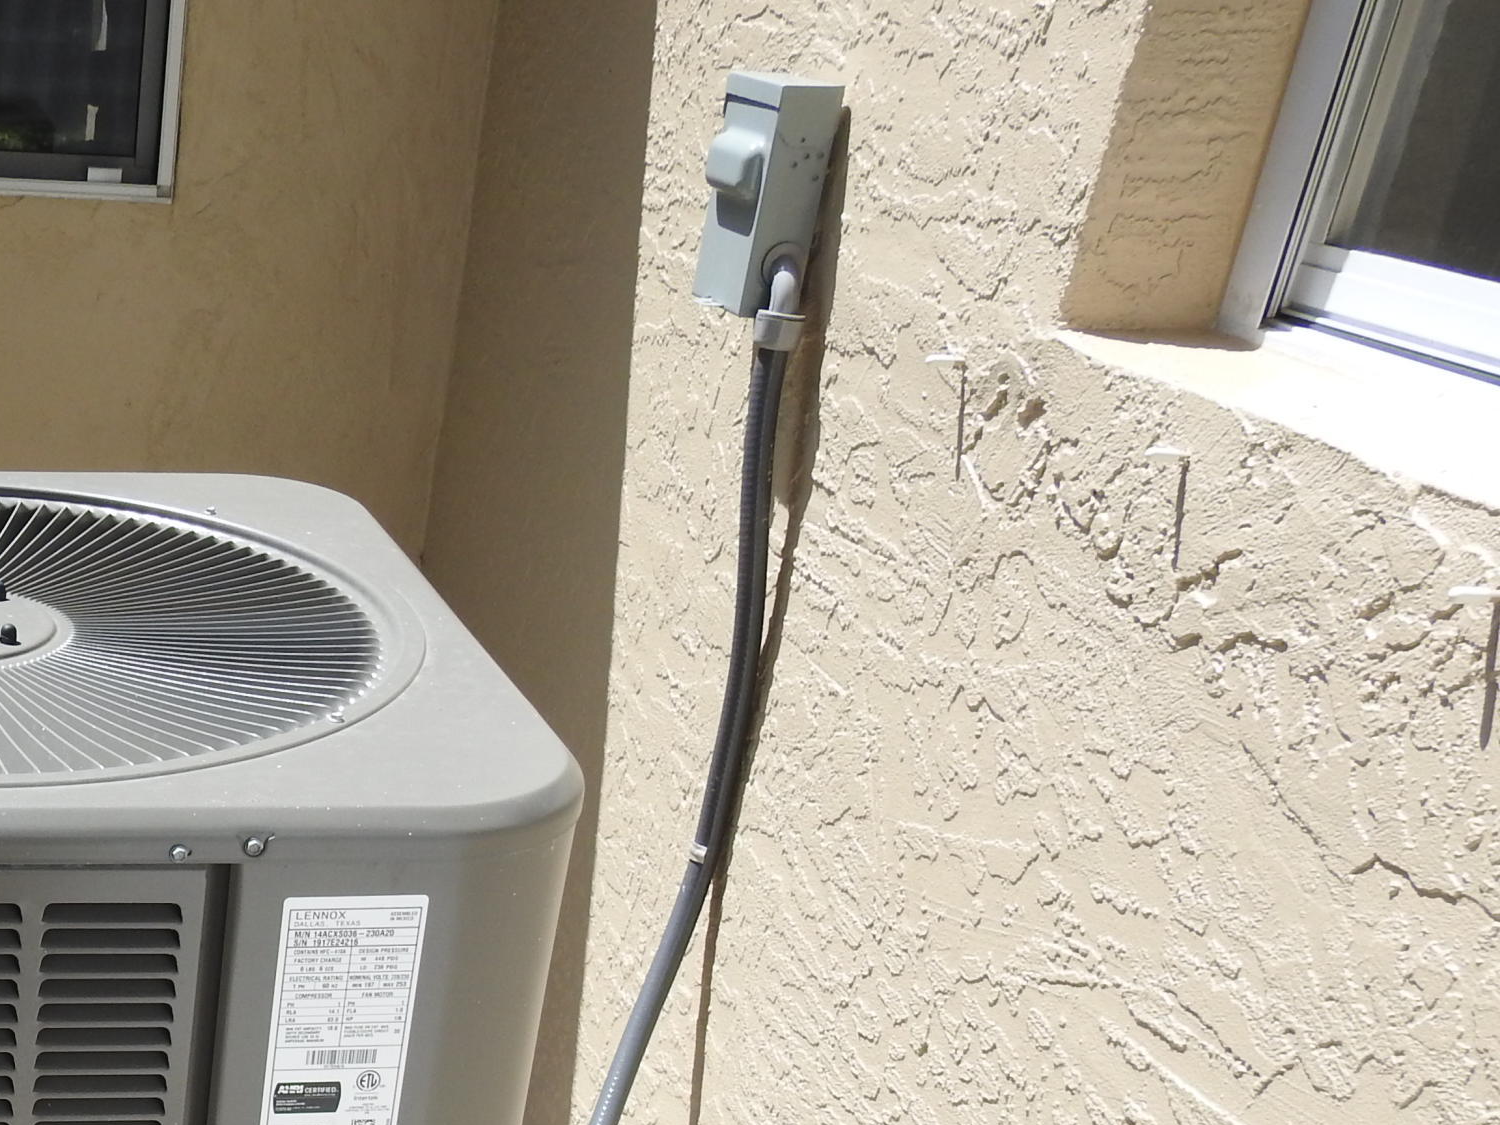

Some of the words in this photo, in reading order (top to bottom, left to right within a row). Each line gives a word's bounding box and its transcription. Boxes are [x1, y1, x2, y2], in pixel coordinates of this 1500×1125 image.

[295, 911, 346, 920] LENNOX
[293, 939, 308, 947] S/N
[294, 992, 333, 1000] COMPRESSOR
[360, 1073, 377, 1089] ETL
